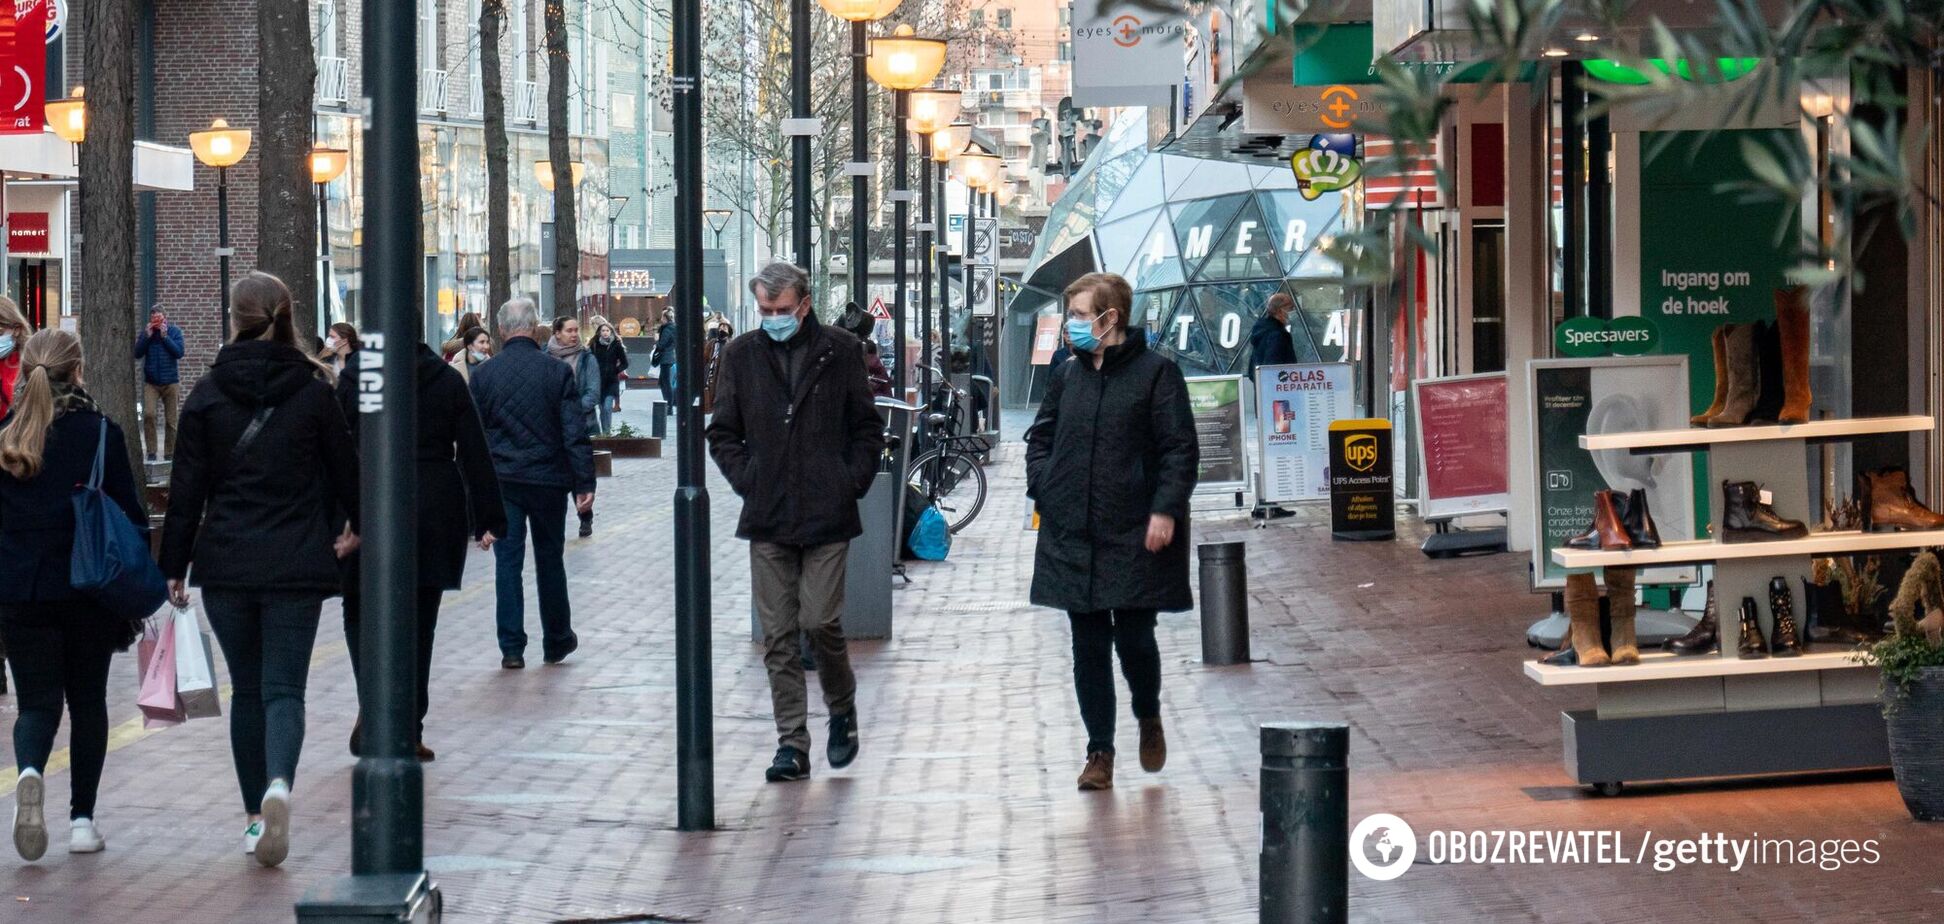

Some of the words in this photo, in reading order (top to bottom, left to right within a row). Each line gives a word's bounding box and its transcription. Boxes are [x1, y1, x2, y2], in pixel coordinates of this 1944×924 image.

[1077, 26, 1112, 39] eyes
[1142, 25, 1182, 34] more
[1272, 101, 1320, 119] eyes
[1662, 269, 1720, 291] Ingang
[1724, 271, 1750, 286] om
[1662, 296, 1684, 315] de
[1687, 296, 1730, 315] hoek
[1176, 308, 1346, 351] TOA
[1564, 328, 1650, 347] Specsavers
[1289, 370, 1325, 382] GLAS
[1276, 381, 1334, 392] REPARATIE
[1348, 445, 1376, 466] ups
[1333, 477, 1348, 485] UPS
[1349, 477, 1371, 485] Access
[1548, 506, 1573, 516] Onze
